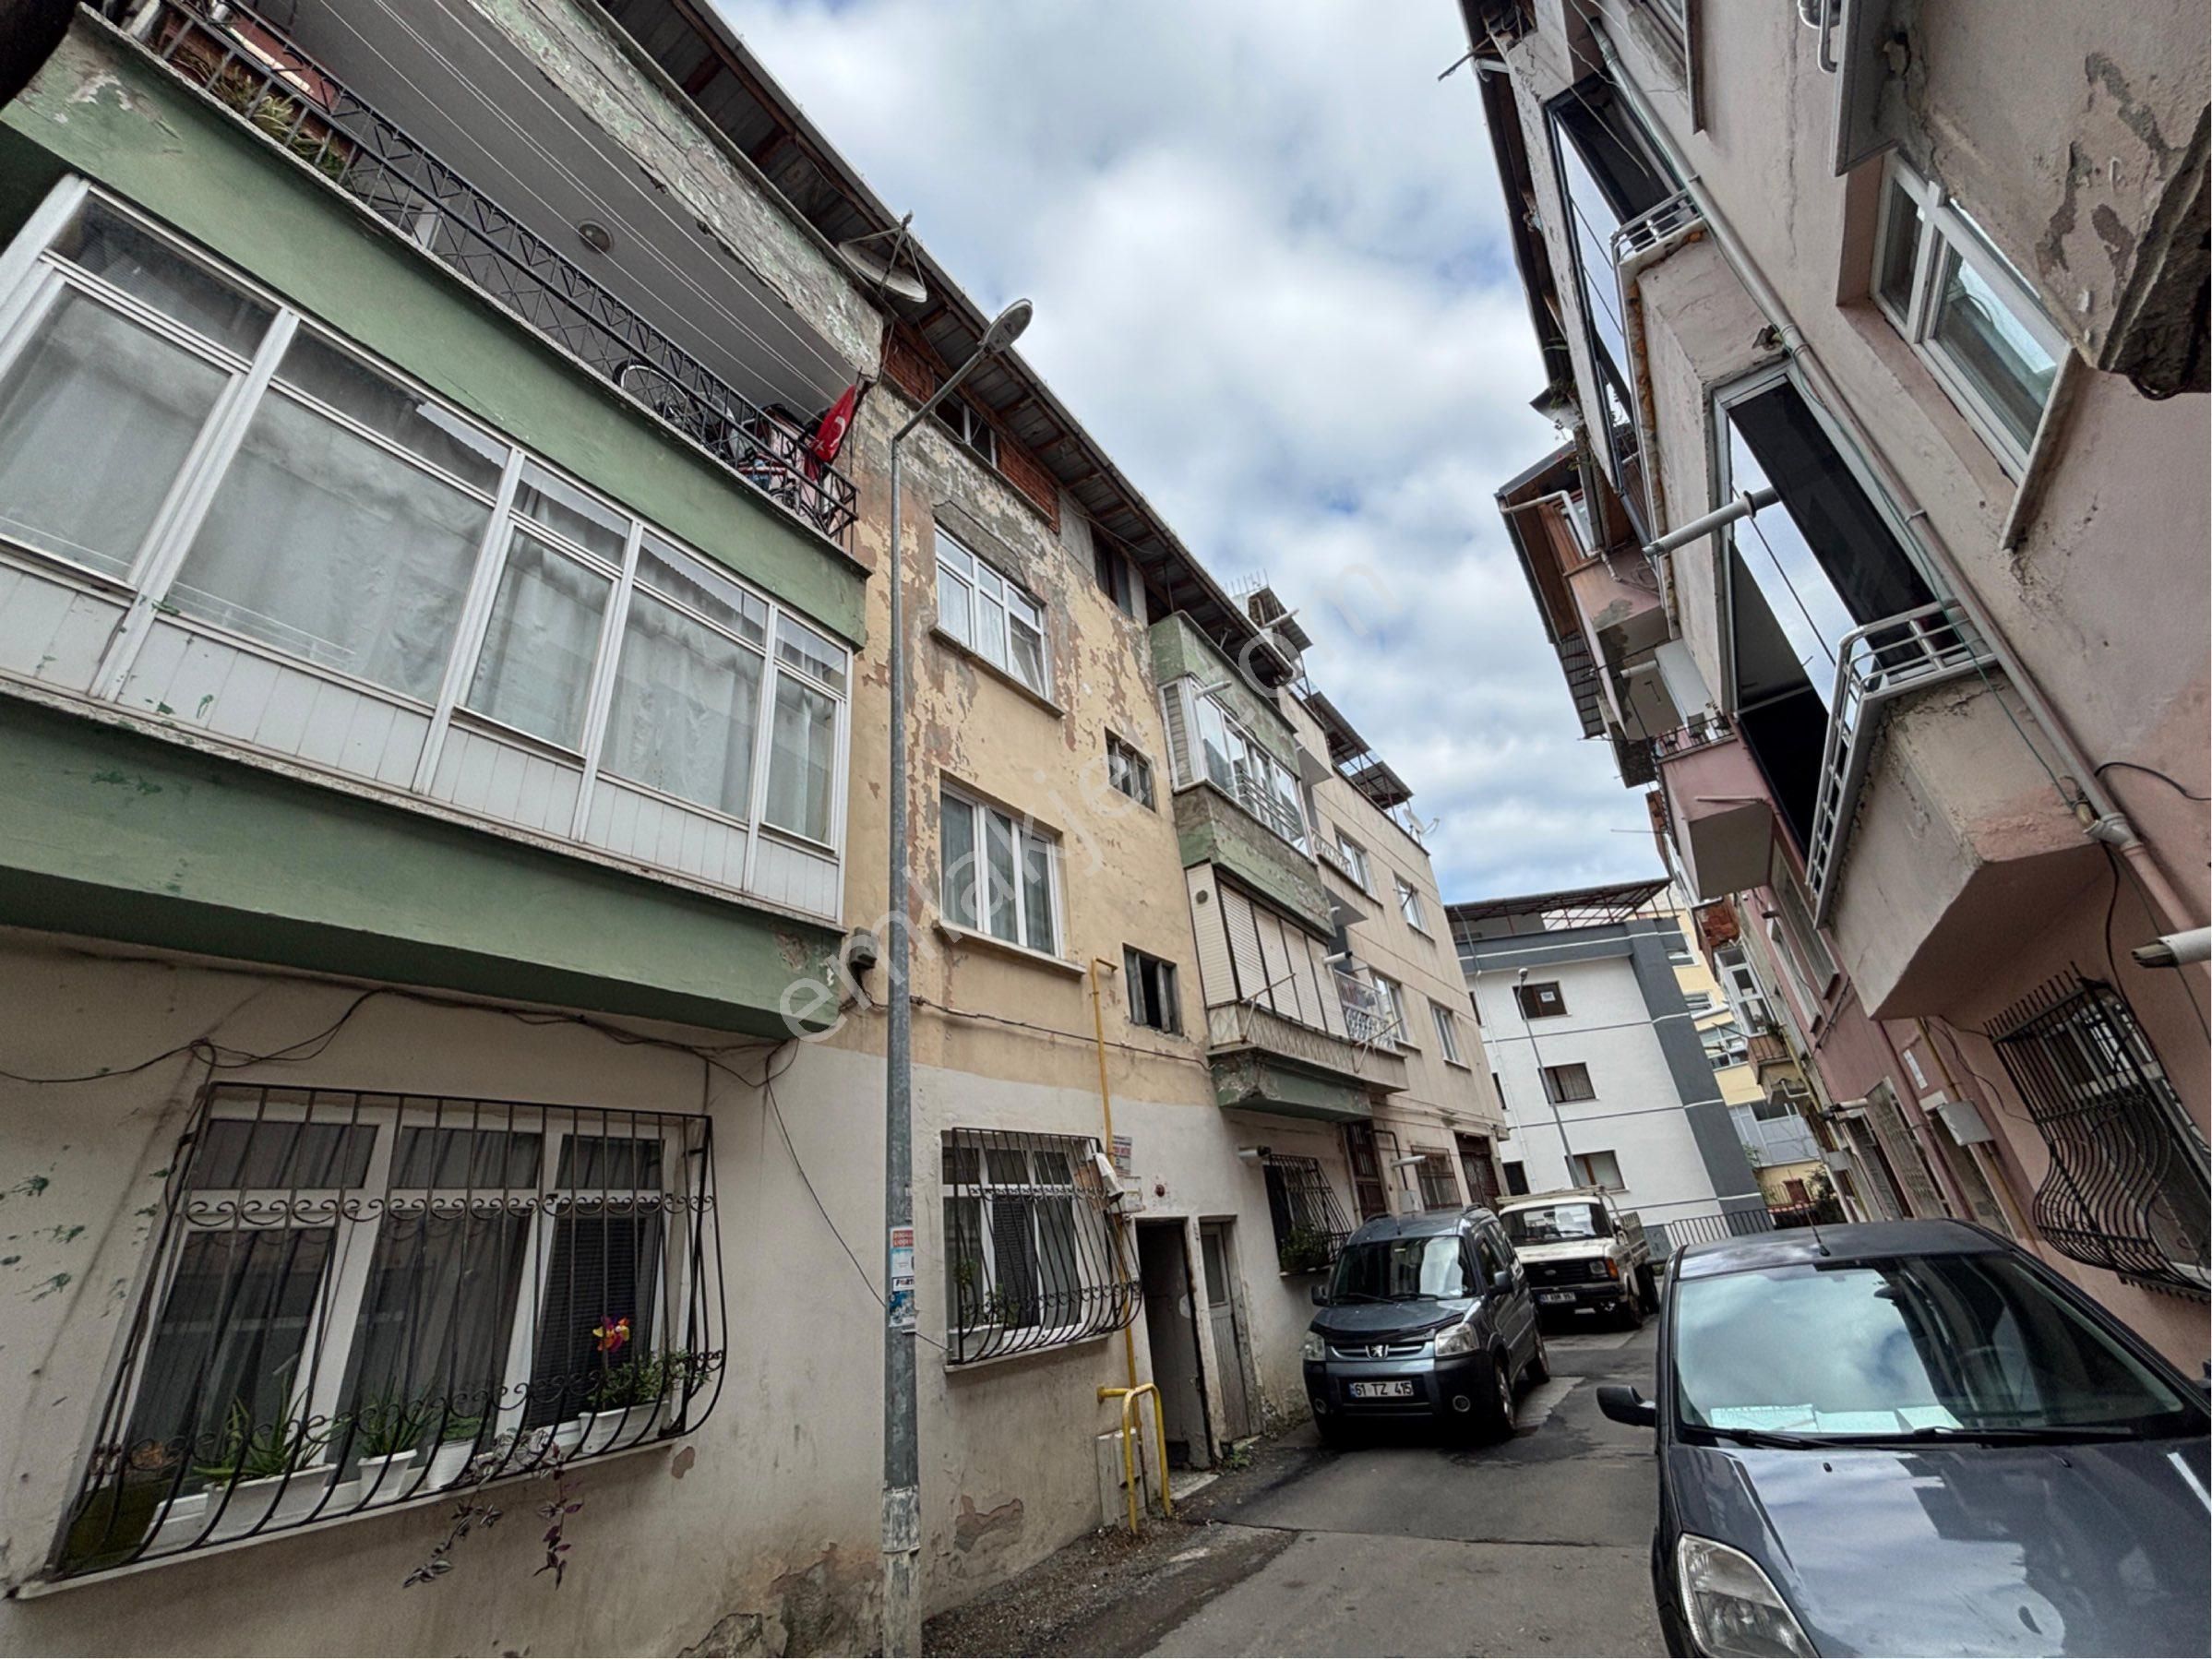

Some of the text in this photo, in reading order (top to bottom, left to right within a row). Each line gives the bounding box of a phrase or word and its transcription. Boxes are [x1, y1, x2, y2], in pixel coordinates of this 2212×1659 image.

[1355, 1382, 1412, 1396] 61 TZ 415
